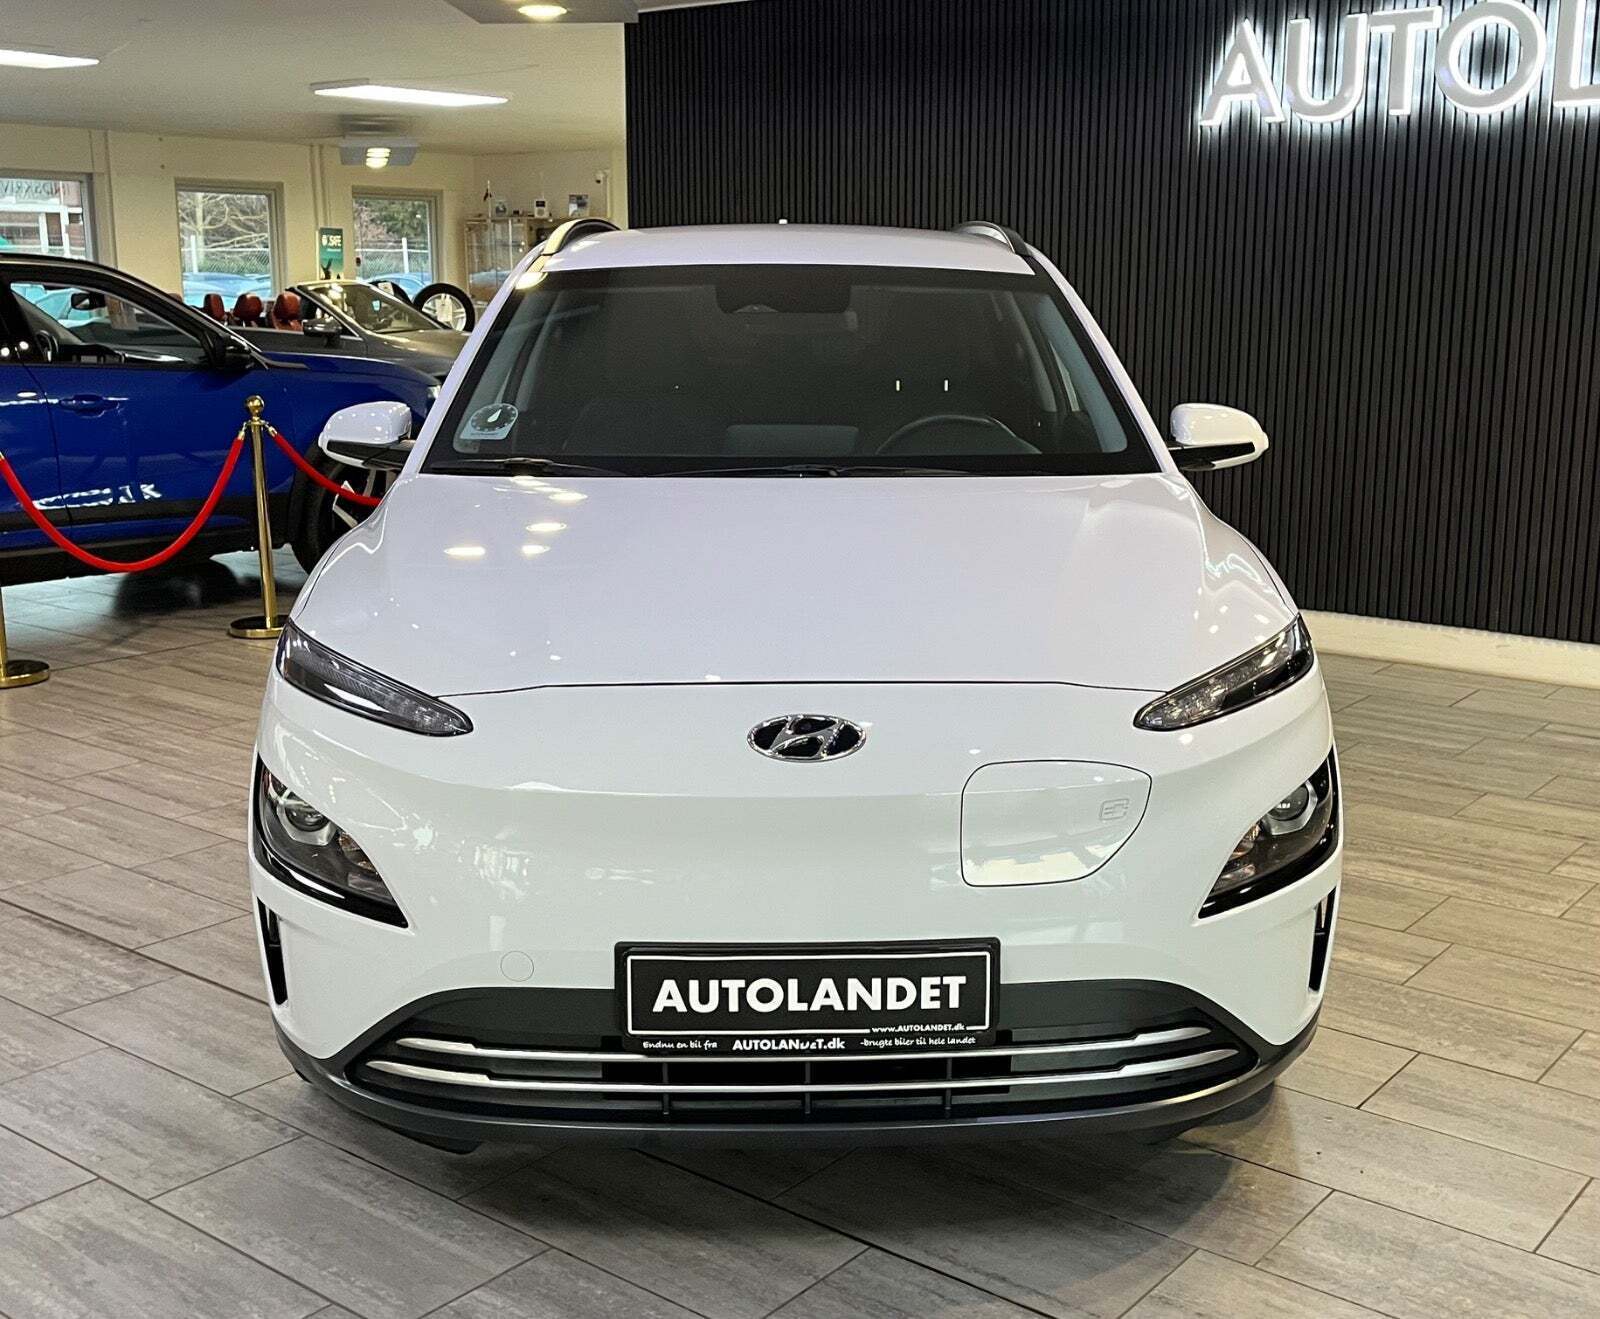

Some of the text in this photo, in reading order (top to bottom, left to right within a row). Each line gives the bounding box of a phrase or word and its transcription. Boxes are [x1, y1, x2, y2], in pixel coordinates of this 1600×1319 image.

[1199, 0, 1600, 126] AUTOL
[652, 976, 967, 1013] AUTOLANDET
[871, 1023, 965, 1033] www.AUTOLANDET.dk
[643, 1041, 674, 1049] Endnu
[690, 1040, 702, 1049] bil
[704, 1040, 718, 1050] fra
[895, 1037, 915, 1046] biler
[916, 1036, 926, 1045] til
[929, 1037, 946, 1045] hele
[947, 1036, 976, 1045] landet
